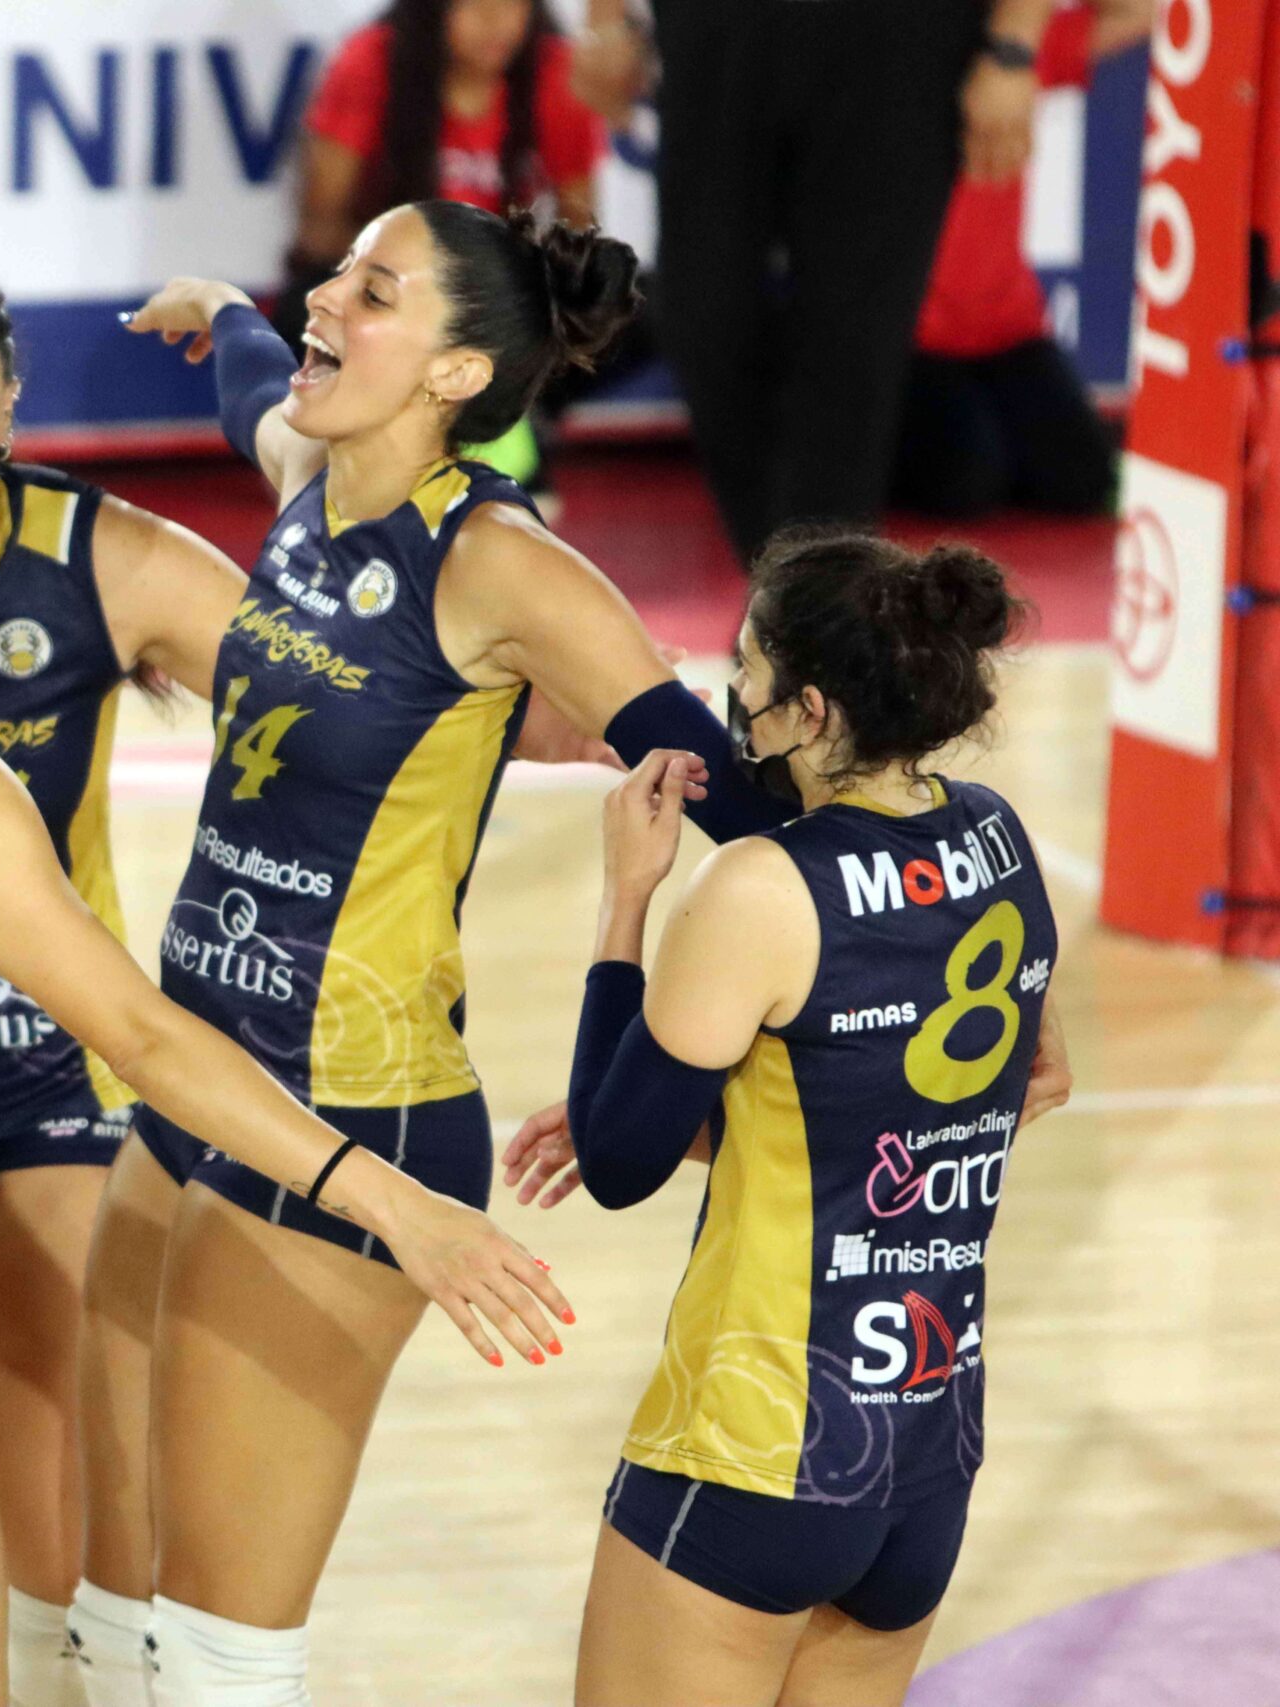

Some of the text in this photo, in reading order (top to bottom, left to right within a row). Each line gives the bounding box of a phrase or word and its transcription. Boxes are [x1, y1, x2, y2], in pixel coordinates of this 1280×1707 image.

[837, 830, 995, 917] Mobil
[161, 918, 295, 1002] ssertus
[904, 900, 1025, 1104] 8
[850, 1390, 898, 1405] Health
